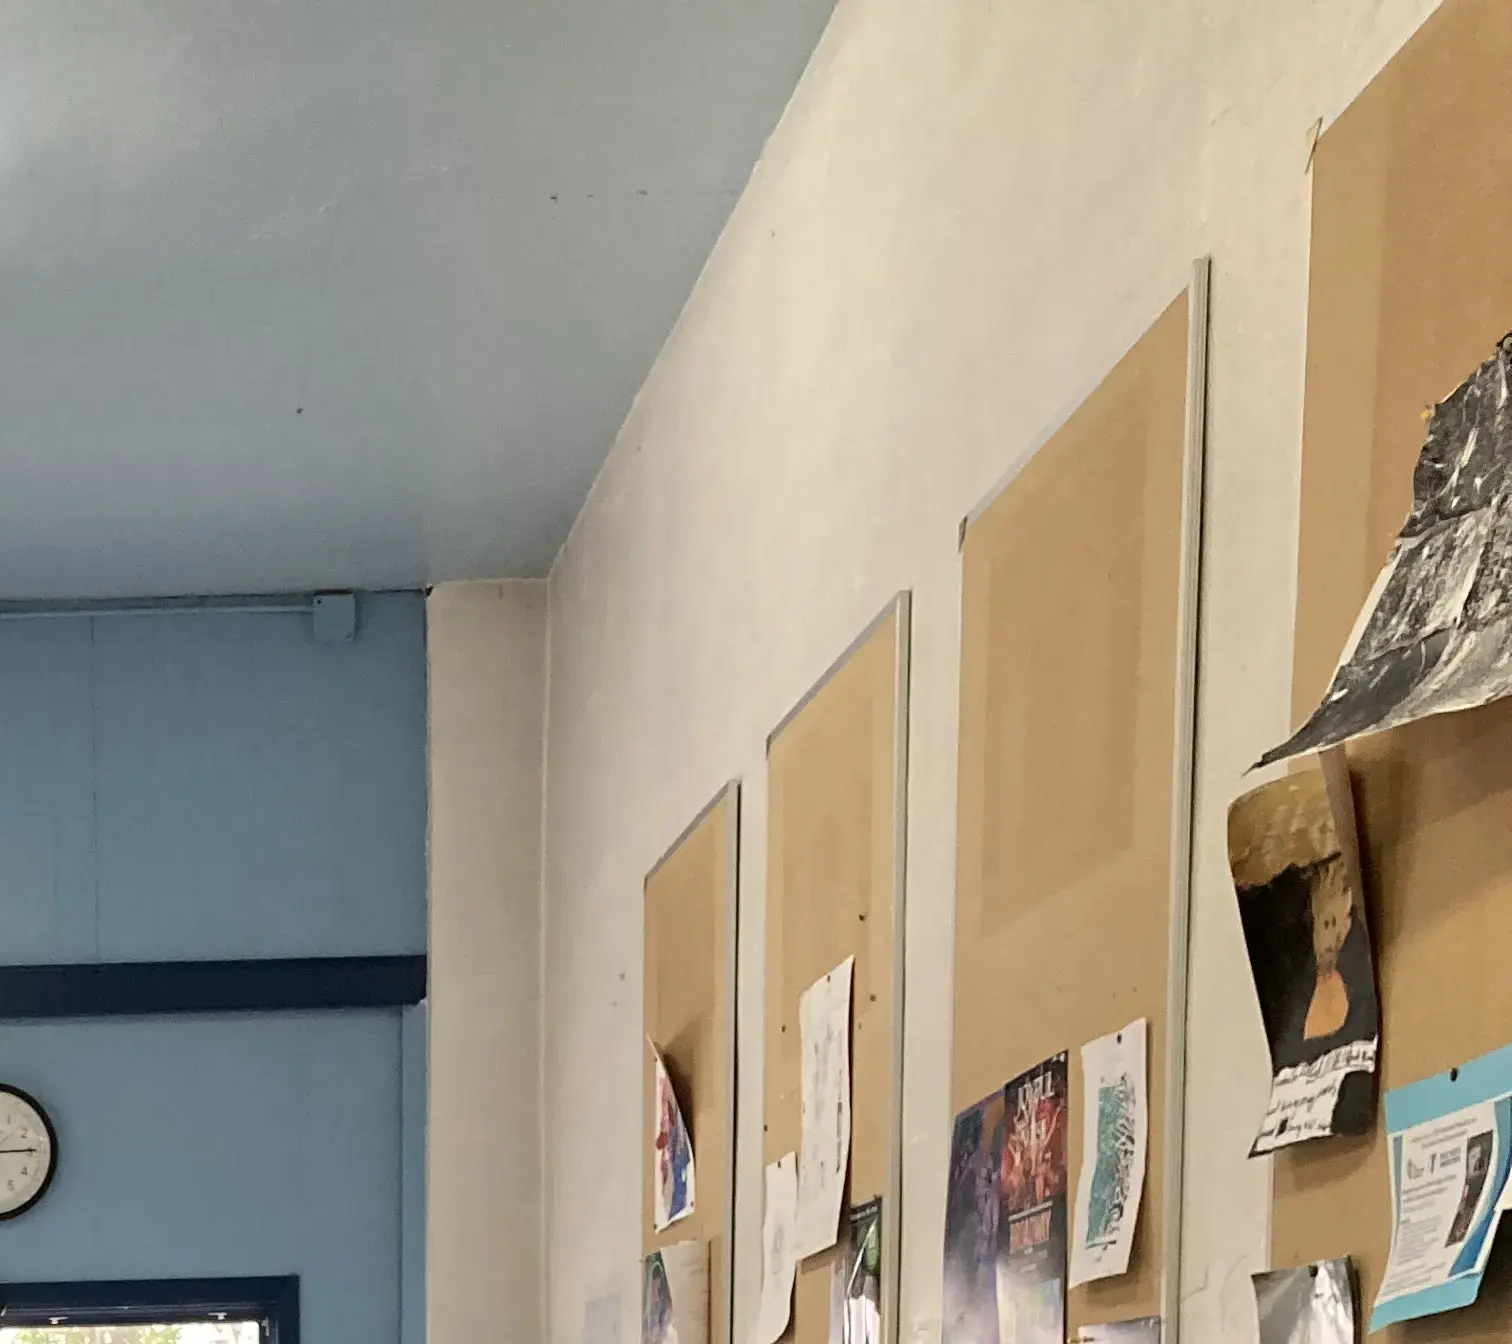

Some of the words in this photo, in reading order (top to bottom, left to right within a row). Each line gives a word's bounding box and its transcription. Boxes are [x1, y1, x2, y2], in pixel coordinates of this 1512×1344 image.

[20, 1127, 28, 1139] 2
[20, 1166, 28, 1176] 4
[7, 1180, 15, 1191] 5
